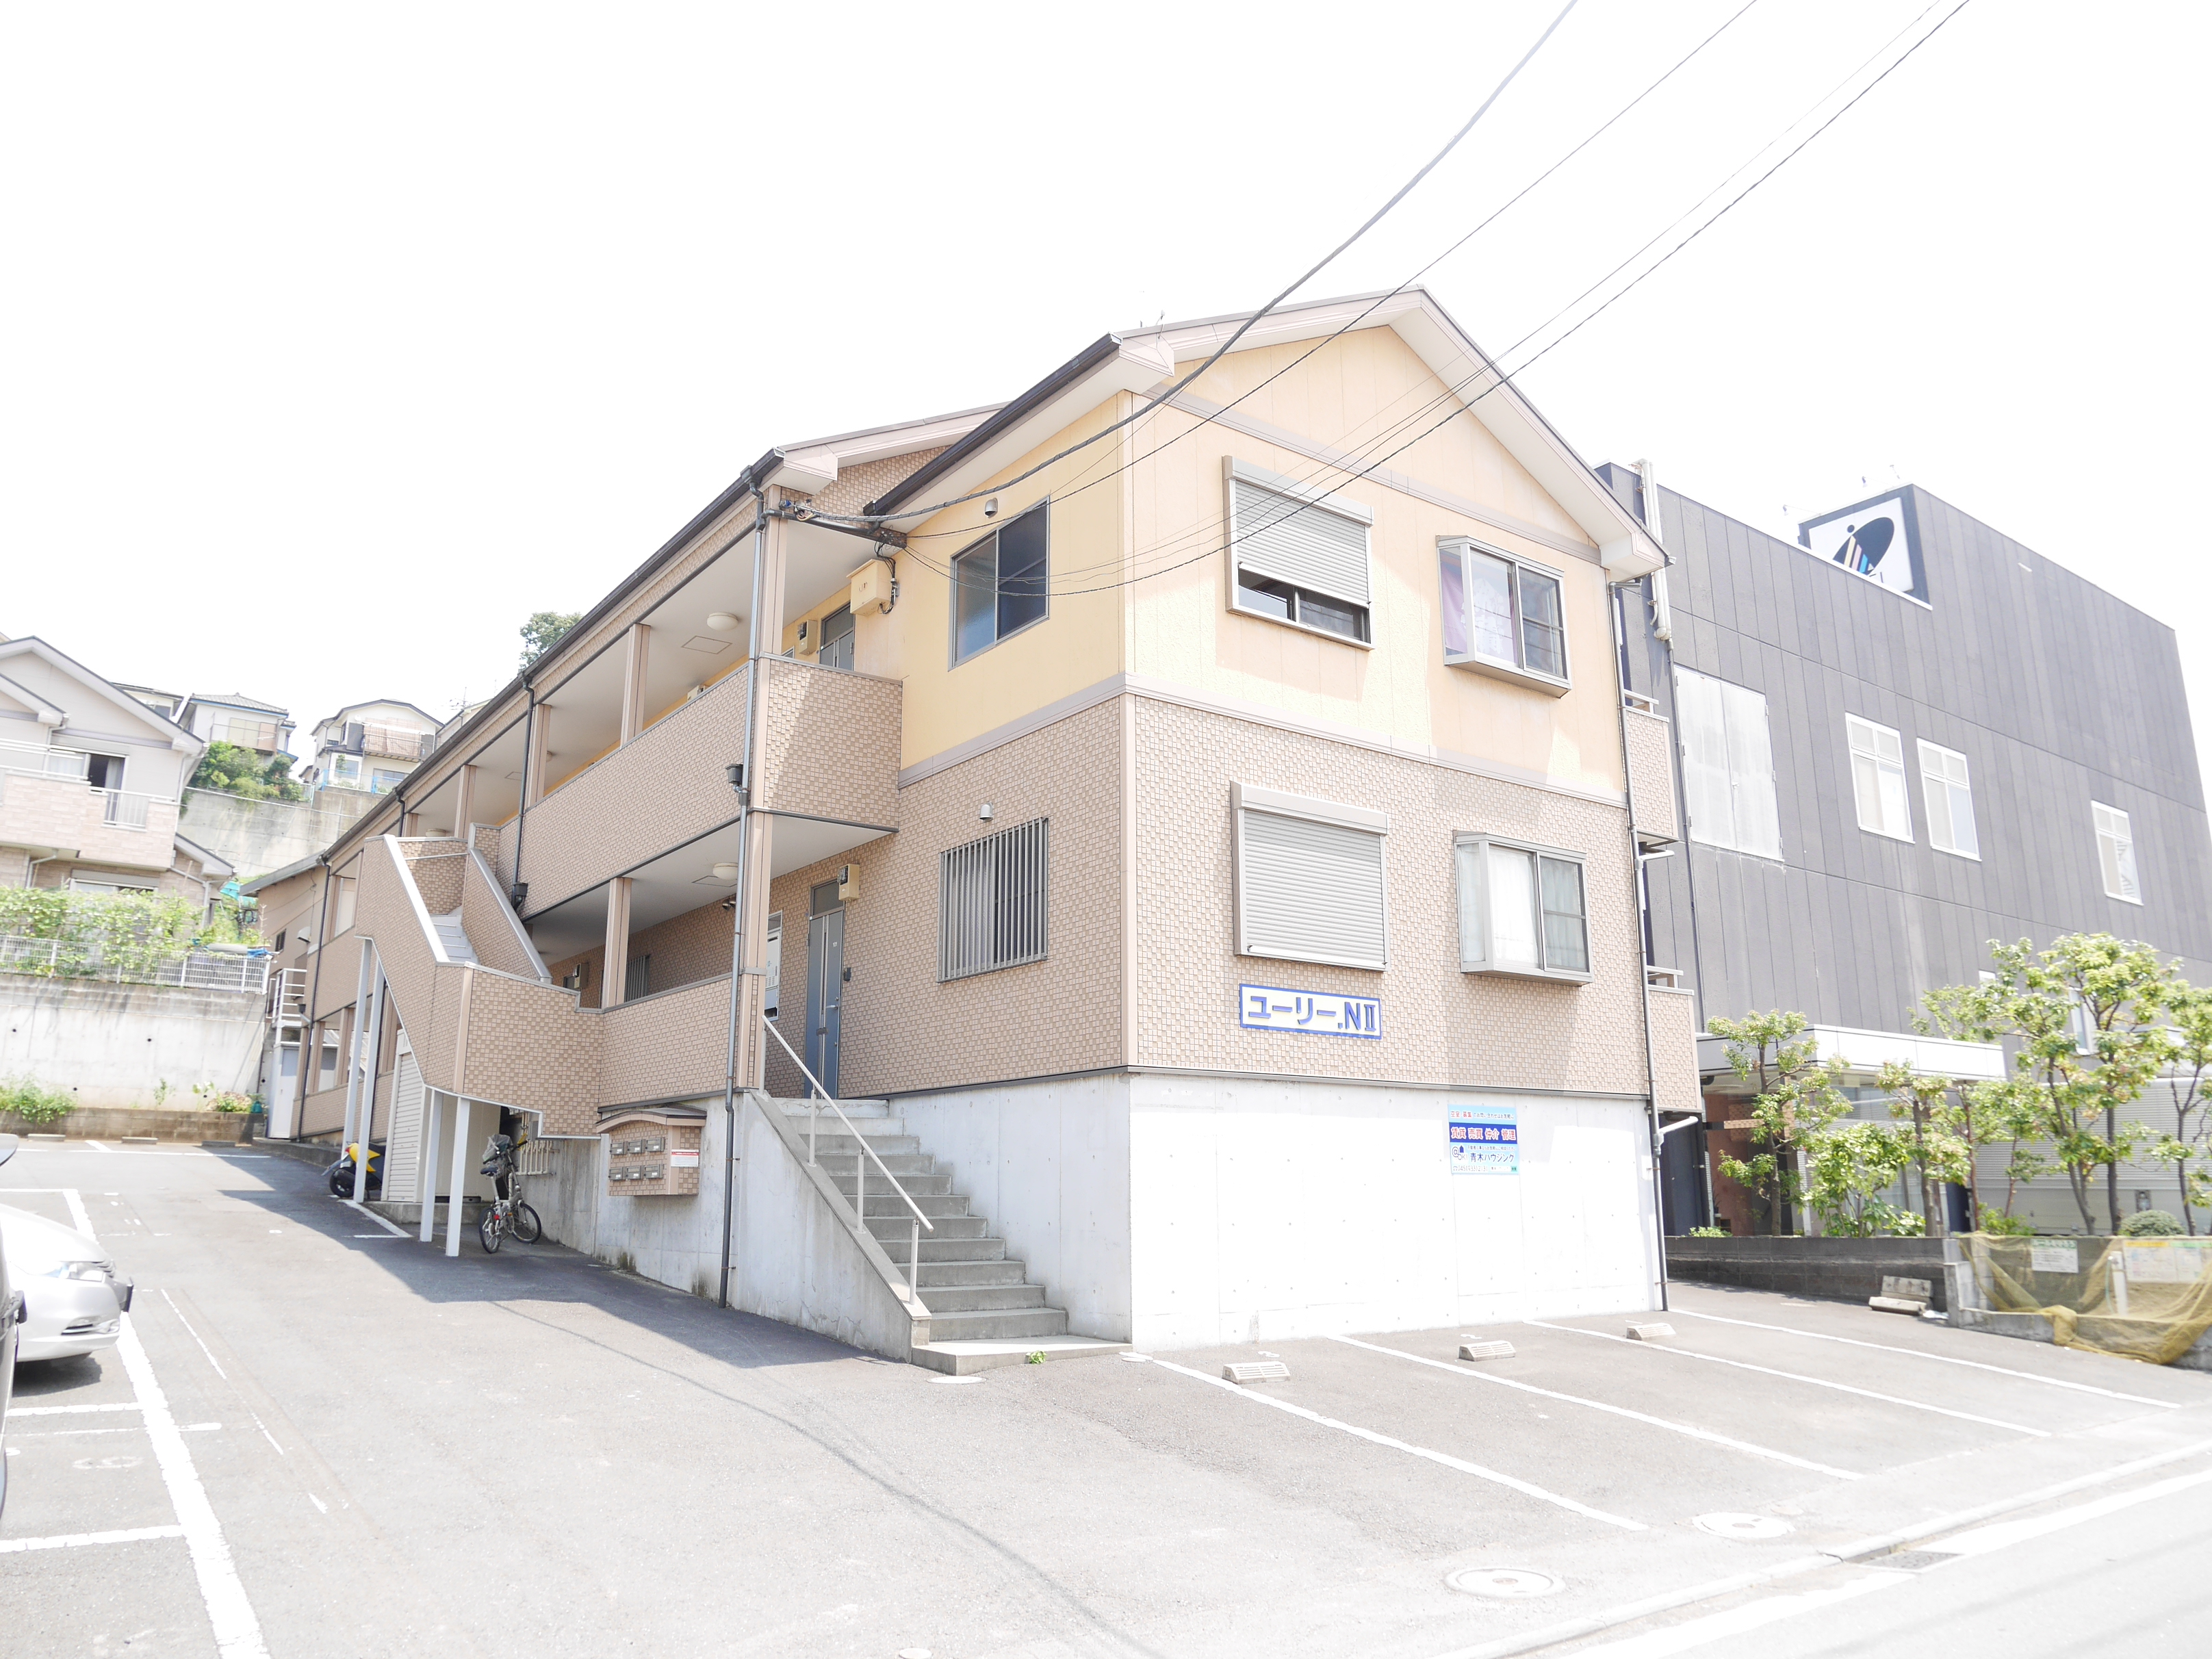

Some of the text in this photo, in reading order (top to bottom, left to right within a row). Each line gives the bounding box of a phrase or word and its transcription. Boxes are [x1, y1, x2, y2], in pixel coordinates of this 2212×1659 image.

[1451, 1127, 1516, 1140] 賃貸 売買 仲介 管理
[1470, 1152, 1514, 1162] 青木ハウジング
